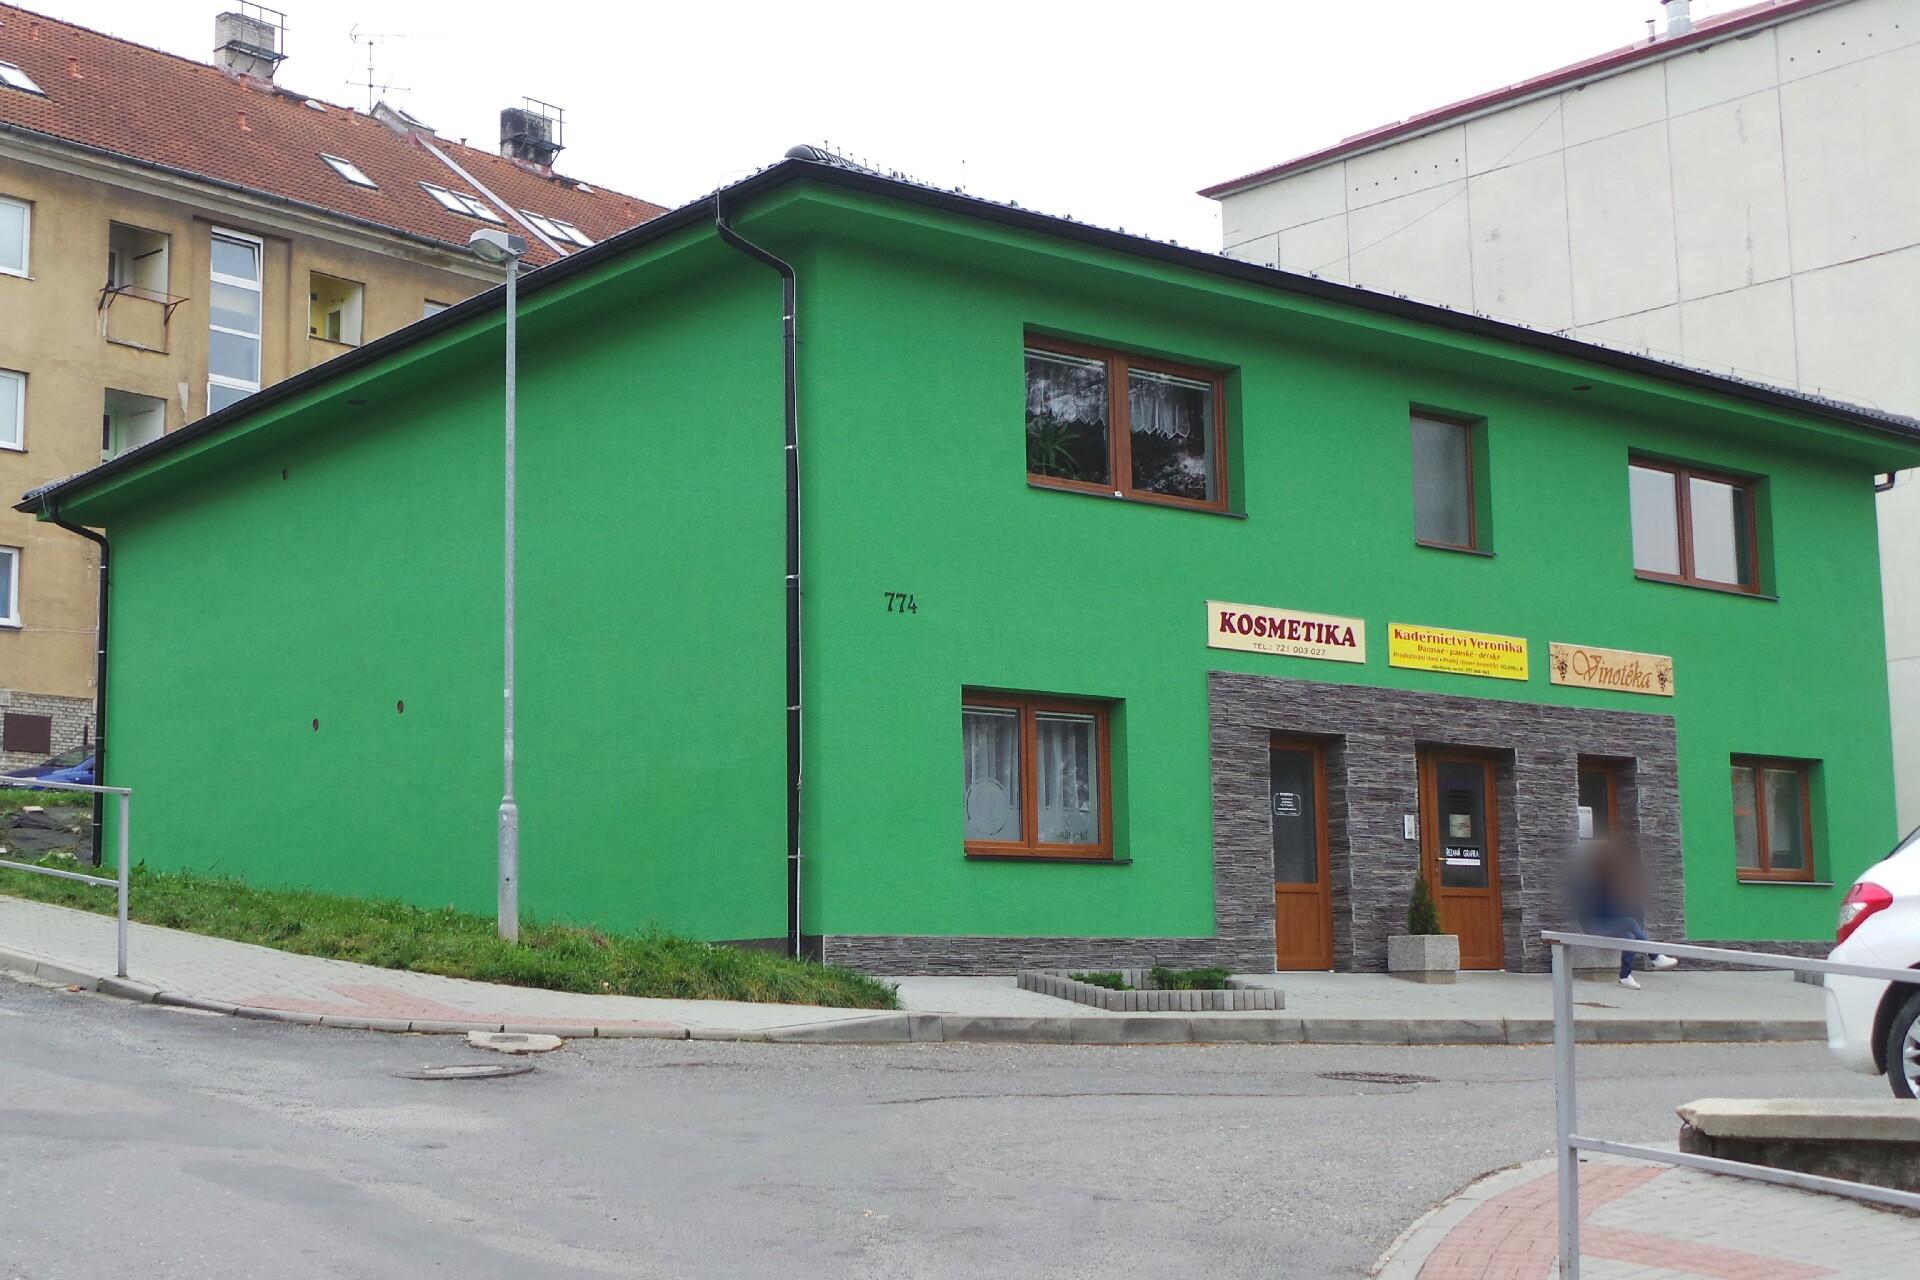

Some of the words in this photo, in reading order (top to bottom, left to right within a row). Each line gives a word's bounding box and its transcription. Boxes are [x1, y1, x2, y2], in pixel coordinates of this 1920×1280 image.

[884, 592, 918, 614] 774
[1219, 611, 1357, 647] KOSMETIKA
[1275, 644, 1290, 652] 721
[1293, 646, 1308, 655] 003
[1310, 648, 1326, 656] 027
[1470, 637, 1523, 653] Veronika
[1573, 650, 1651, 689] Vinotéka
